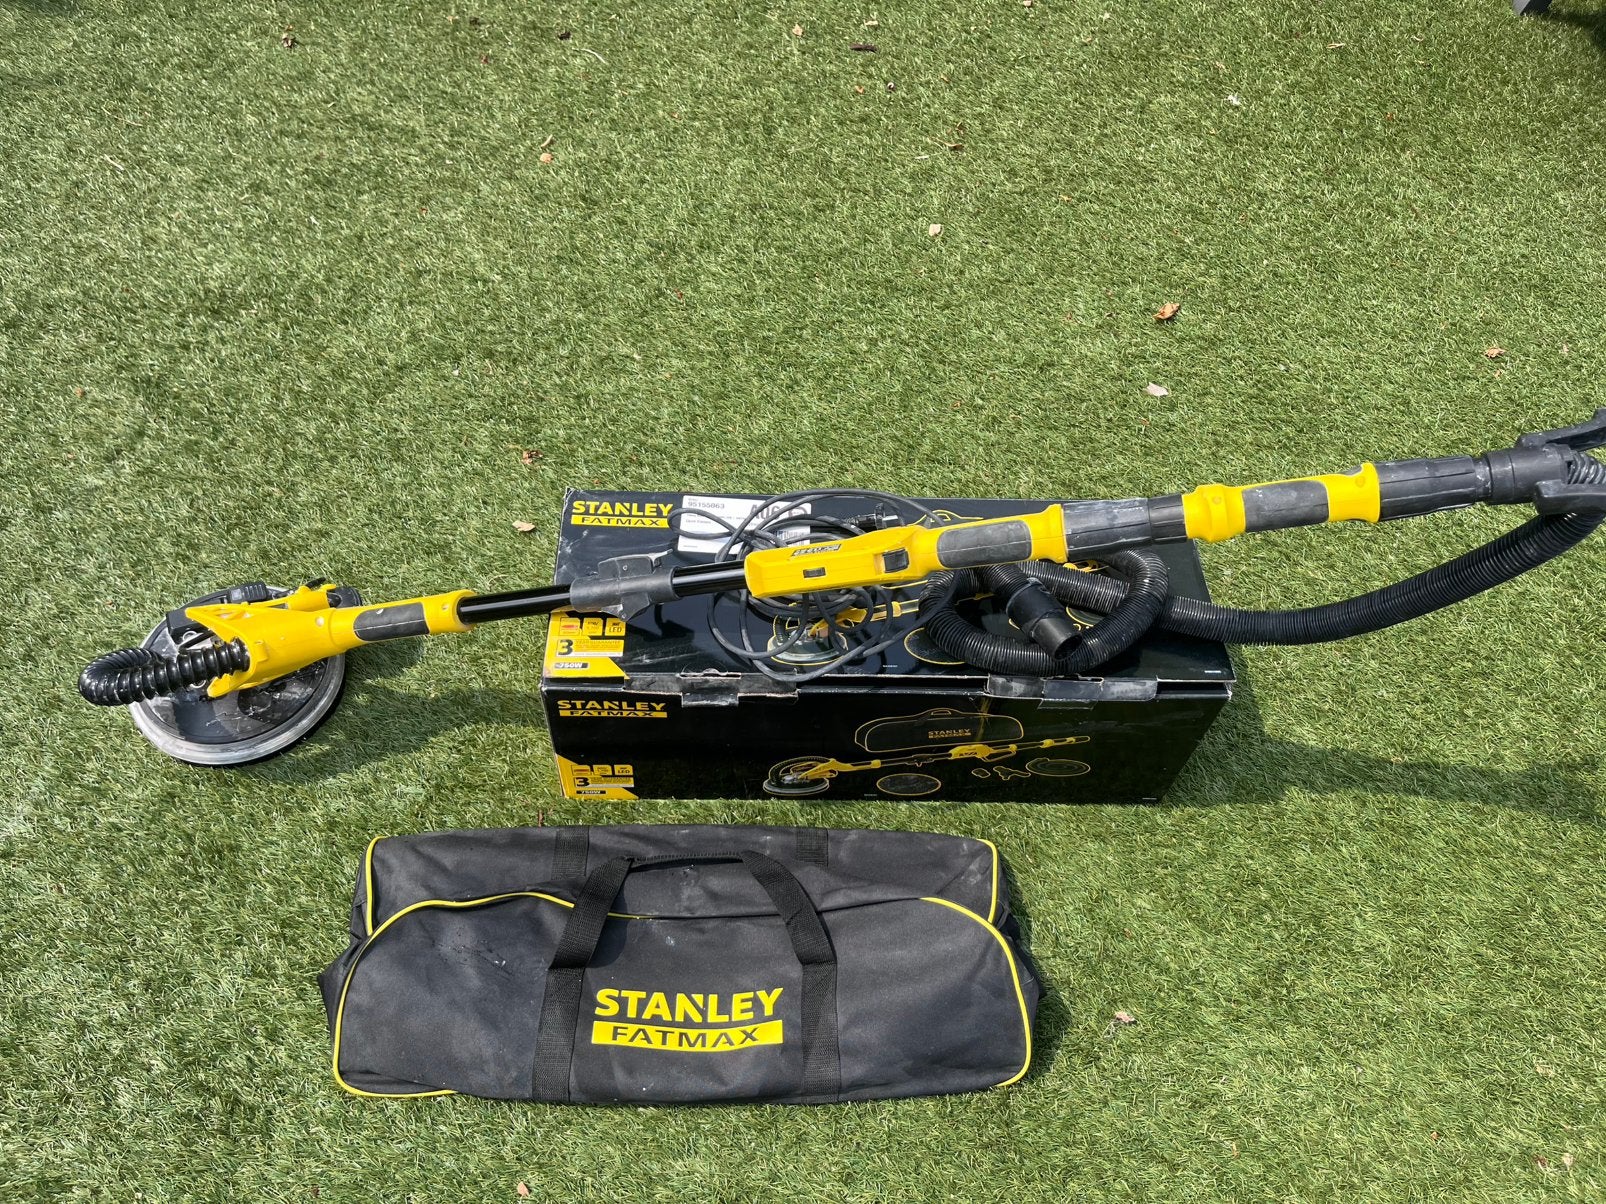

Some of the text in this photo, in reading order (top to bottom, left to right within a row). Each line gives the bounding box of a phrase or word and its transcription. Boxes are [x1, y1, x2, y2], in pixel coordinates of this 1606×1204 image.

[571, 500, 673, 516] STANLEY
[581, 516, 660, 526] FATMAX
[558, 639, 574, 656] 3
[557, 700, 666, 711] STANLEY
[576, 777, 590, 787] 3
[594, 987, 784, 1023] STANLEY
[611, 1025, 759, 1048] FATMAX
